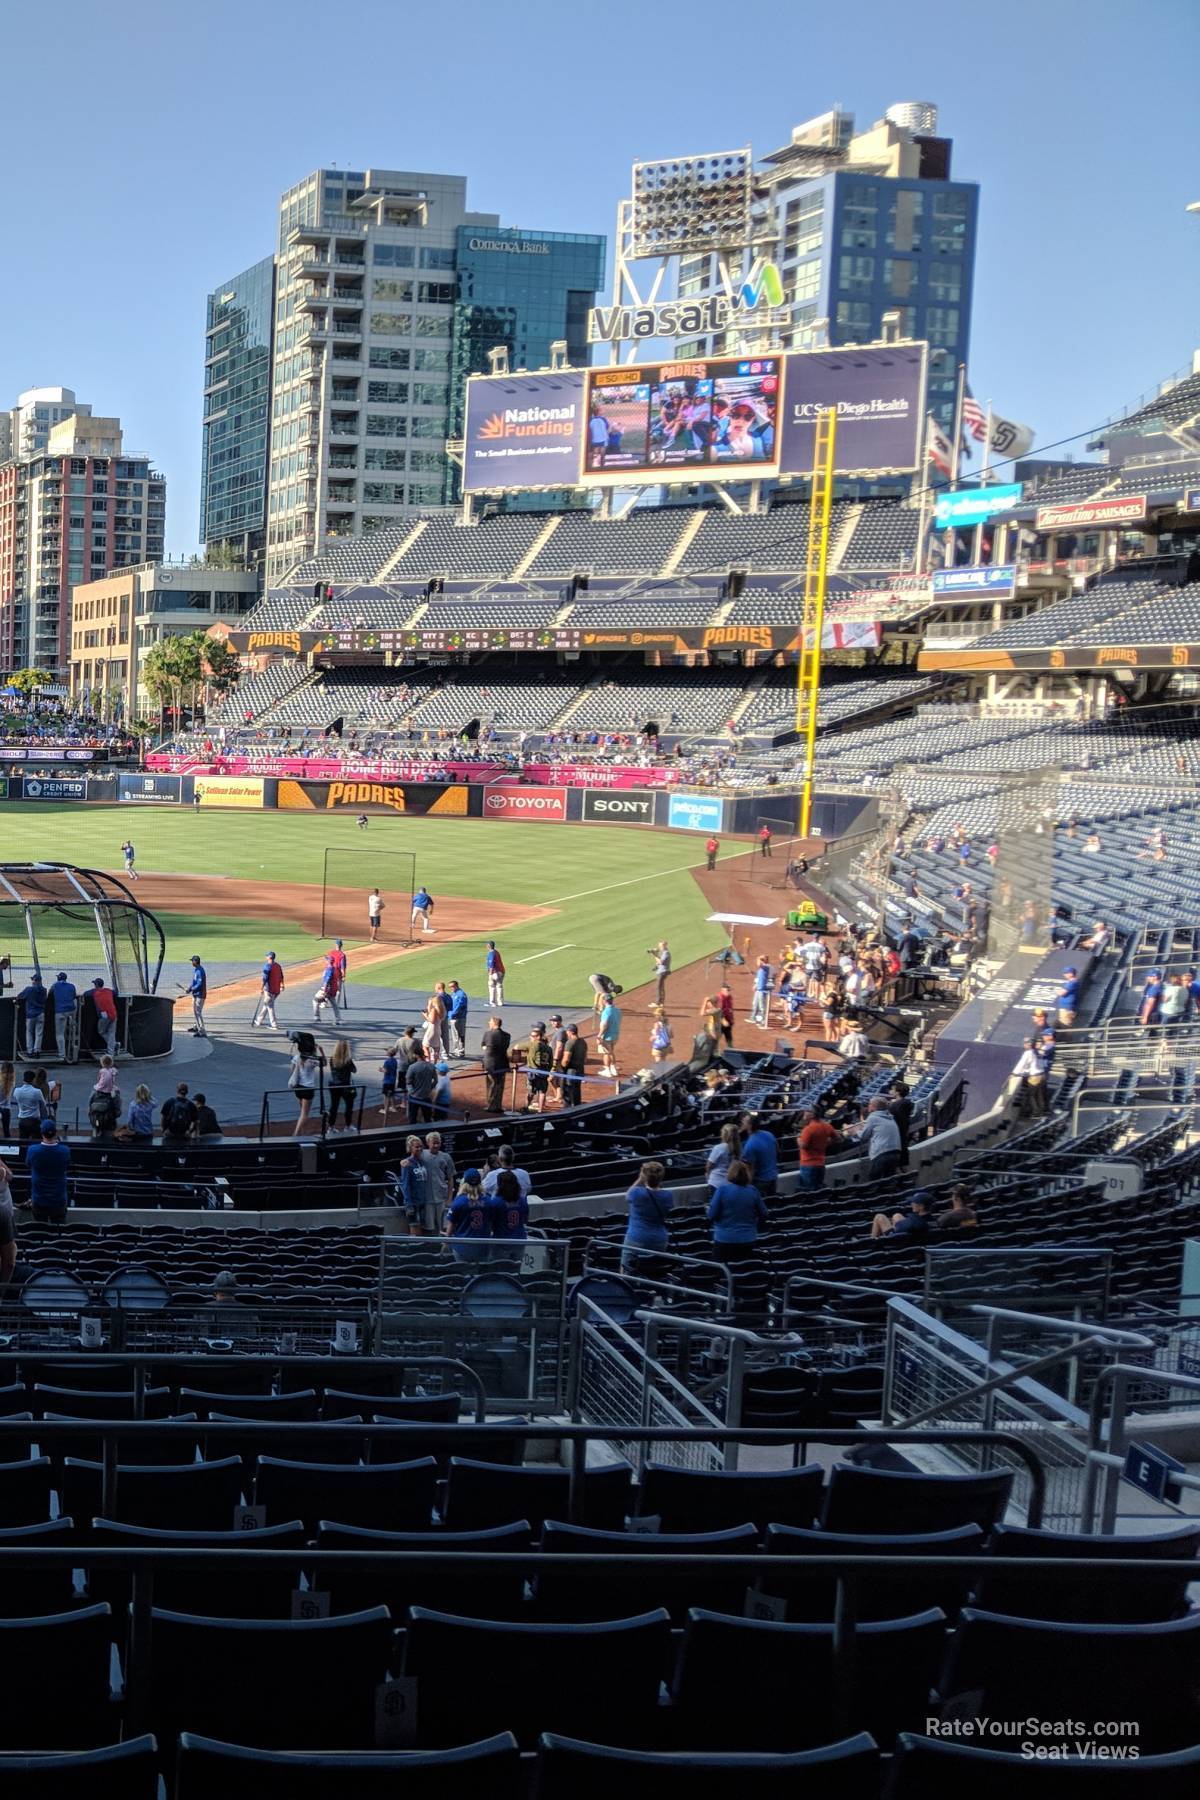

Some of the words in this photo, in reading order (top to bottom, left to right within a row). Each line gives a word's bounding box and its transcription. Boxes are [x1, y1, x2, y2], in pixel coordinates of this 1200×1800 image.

[521, 241, 550, 255] Bank
[594, 295, 725, 340] Viasat
[505, 404, 576, 423] National
[504, 418, 574, 438] Funding
[1095, 503, 1141, 520] SAUSAGES
[248, 632, 301, 652] PADRES
[703, 626, 774, 648] PADRES
[1096, 647, 1138, 666] PADRES
[341, 760, 380, 774] HOME
[381, 761, 408, 775] RUN
[43, 783, 83, 793] PENFED
[327, 782, 405, 812] PADRES
[508, 796, 563, 810] TOYOTA
[594, 800, 650, 813] SONY
[471, 1210, 483, 1230] 3
[1139, 1461, 1150, 1481] E
